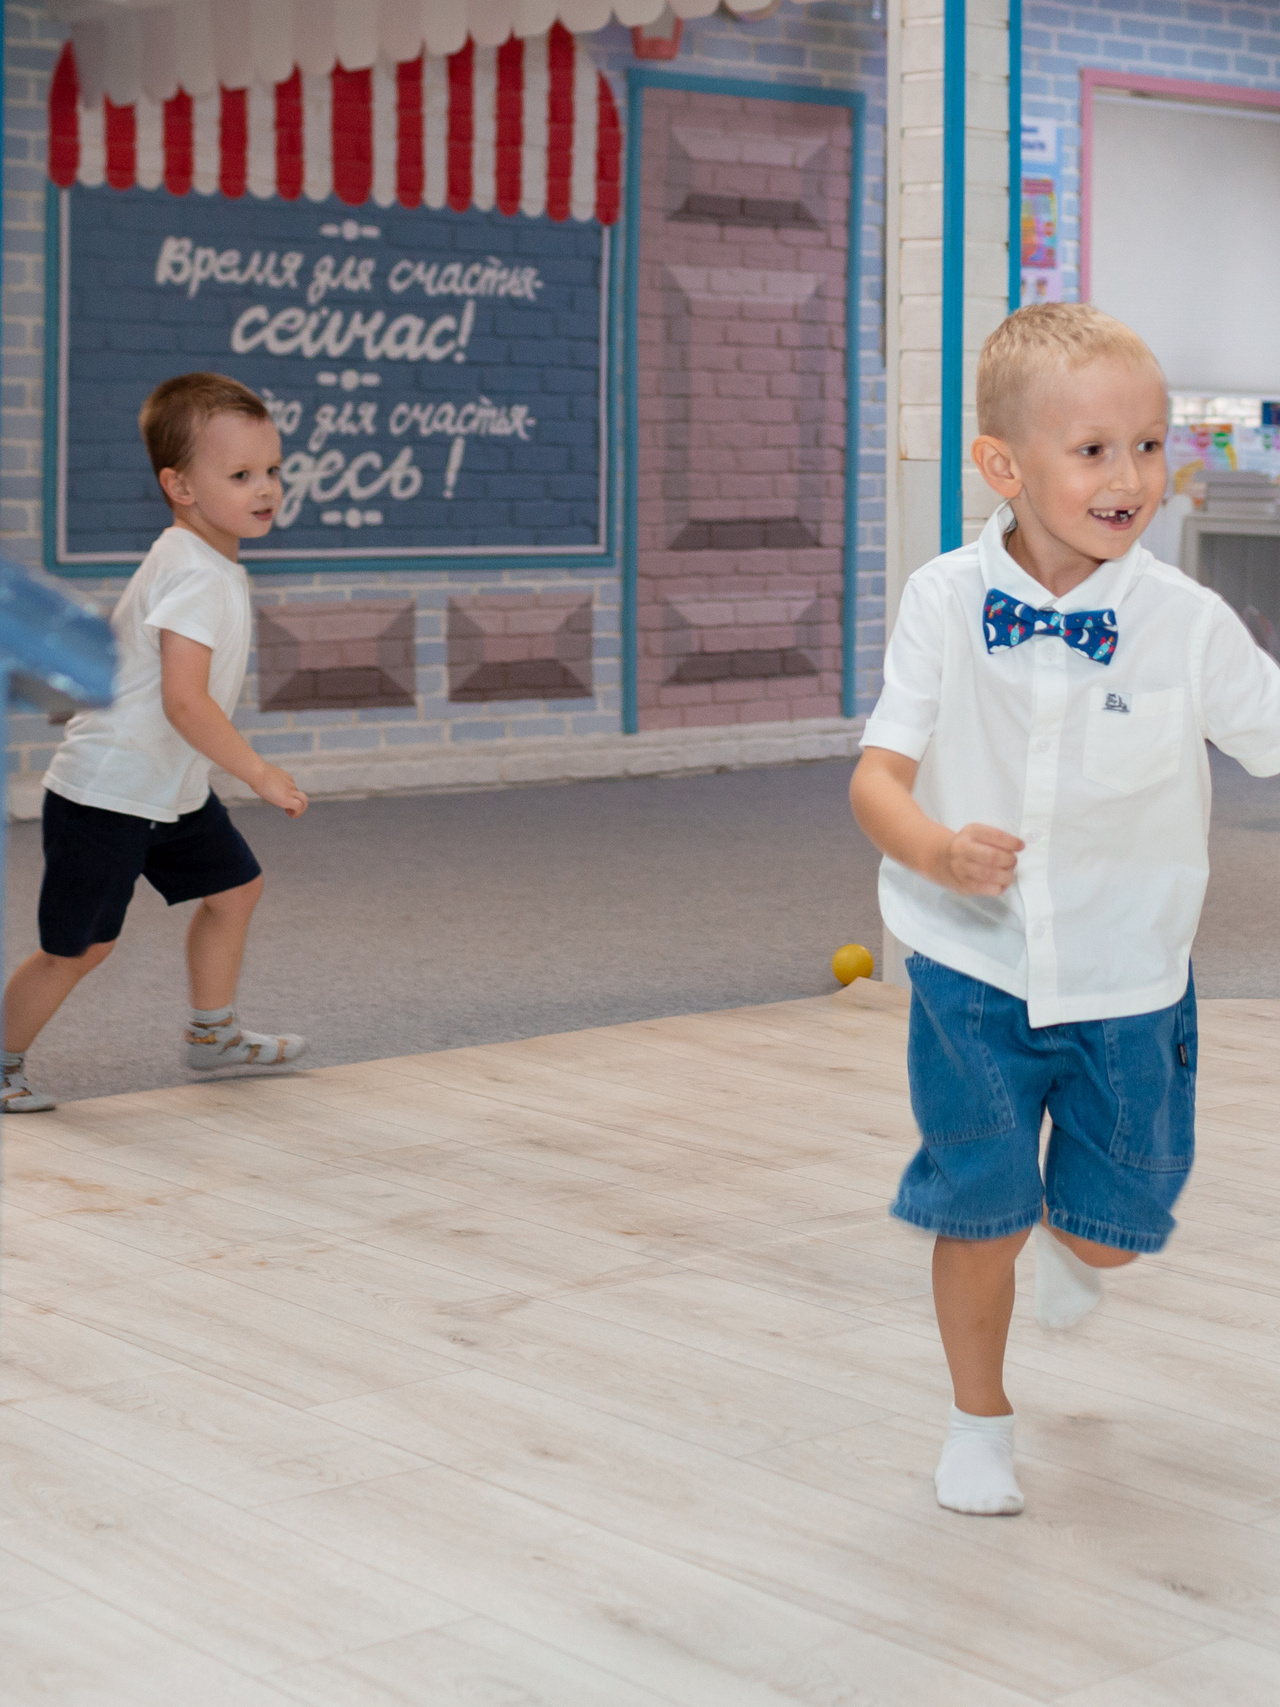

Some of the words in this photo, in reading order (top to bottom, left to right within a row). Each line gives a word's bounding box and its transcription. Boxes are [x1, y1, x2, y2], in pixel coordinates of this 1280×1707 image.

[155, 236, 304, 299] Время
[307, 255, 374, 304] для
[231, 299, 476, 364] сейчас!
[307, 401, 378, 453] для
[275, 446, 423, 529] десь
